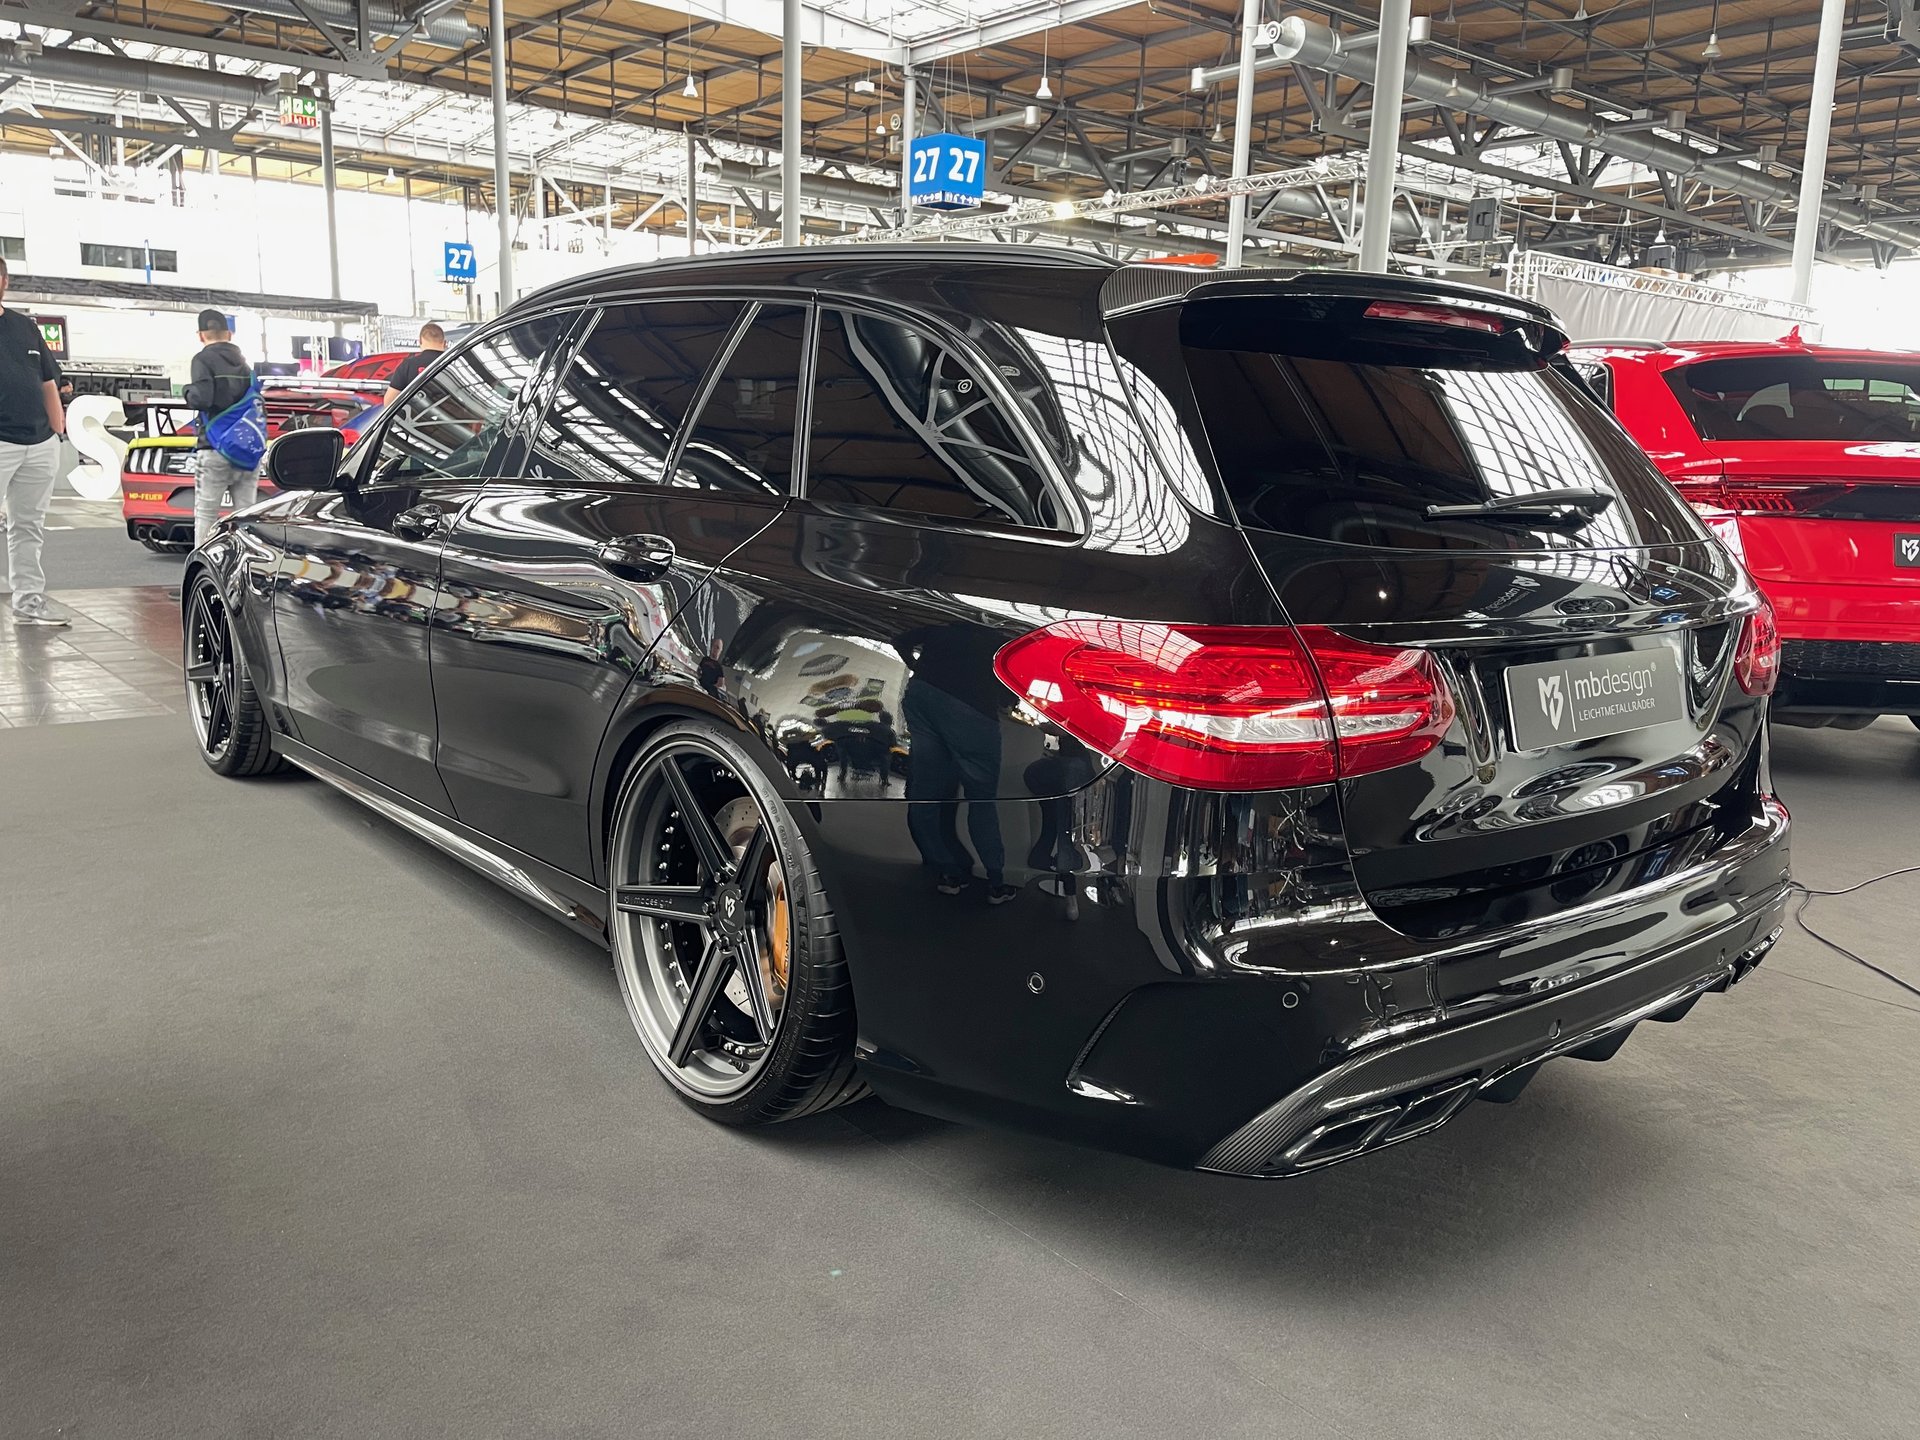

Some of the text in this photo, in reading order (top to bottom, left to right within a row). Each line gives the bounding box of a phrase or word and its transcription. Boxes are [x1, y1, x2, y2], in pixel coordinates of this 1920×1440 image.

[913, 147, 940, 183] 27
[948, 147, 980, 184] 27
[448, 247, 473, 270] 27
